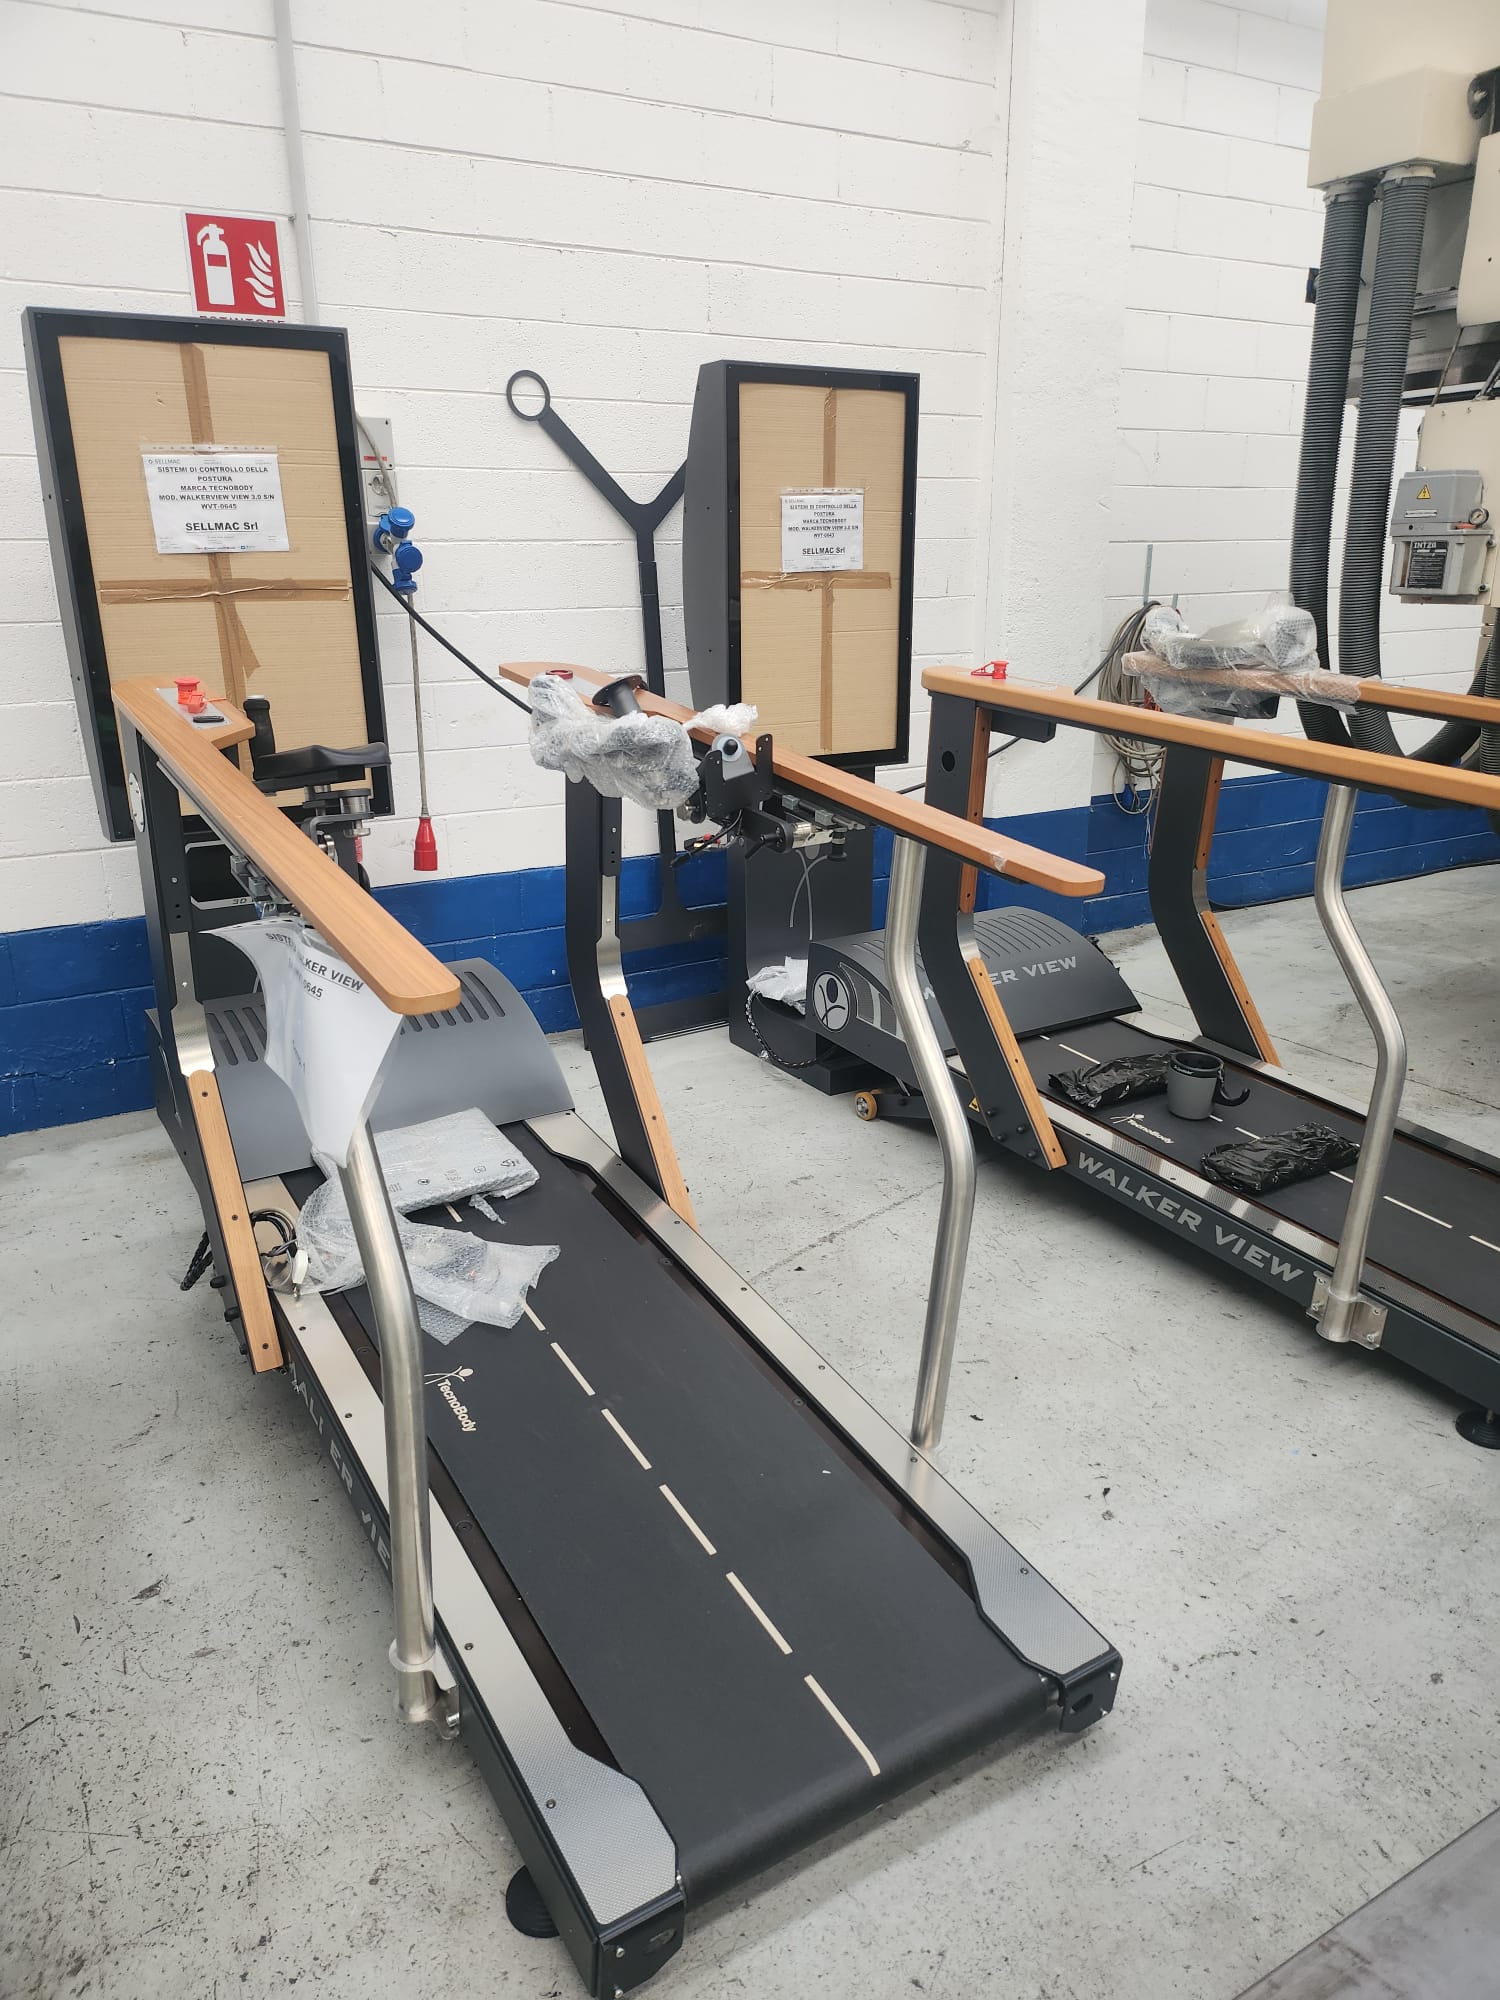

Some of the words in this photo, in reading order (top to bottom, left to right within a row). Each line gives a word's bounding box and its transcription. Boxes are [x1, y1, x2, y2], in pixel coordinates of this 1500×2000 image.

[185, 522, 240, 531] SELLMAC
[243, 522, 258, 530] Srl
[1022, 956, 1077, 978] VIEW
[331, 970, 364, 992] VIEW
[1078, 1152, 1203, 1232] WALKER
[1215, 1224, 1304, 1282] VIEW
[437, 1378, 477, 1432] TecnoBody
